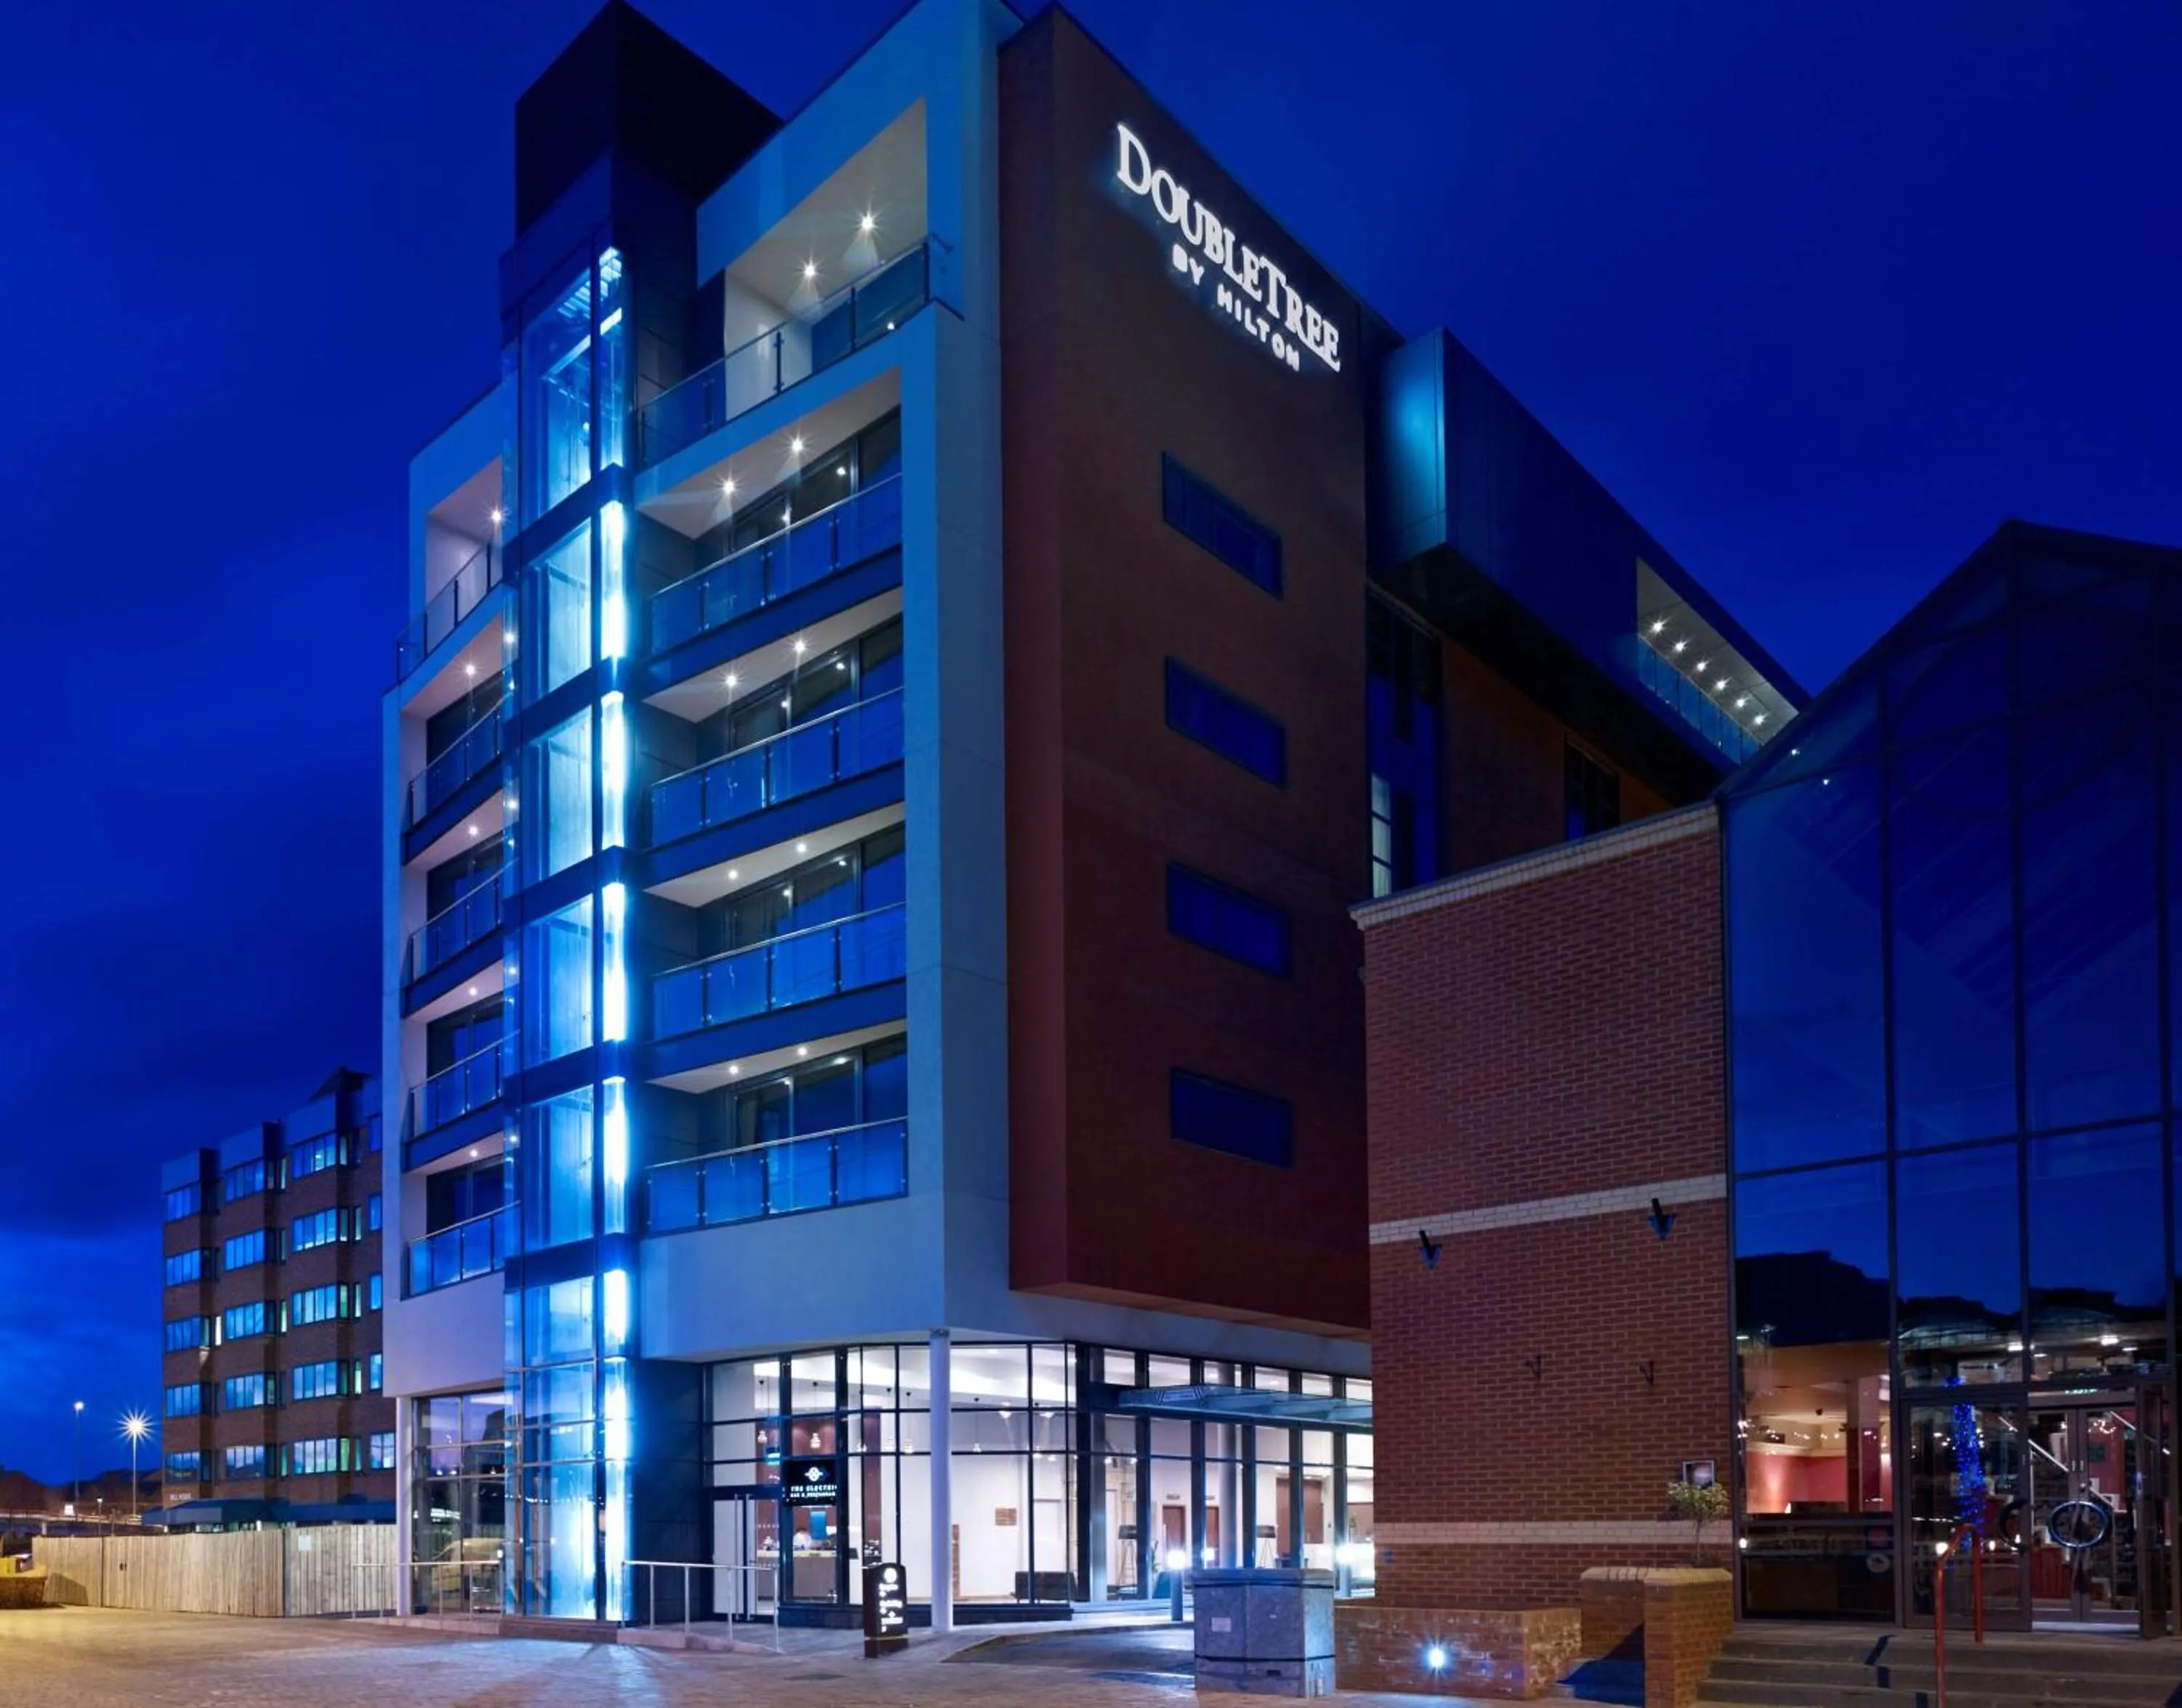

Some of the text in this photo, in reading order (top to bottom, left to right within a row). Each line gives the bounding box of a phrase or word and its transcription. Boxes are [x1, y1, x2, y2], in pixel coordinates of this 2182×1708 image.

[1117, 124, 1340, 372] DOUBLETREE
[1172, 244, 1300, 372] BY HILTON
